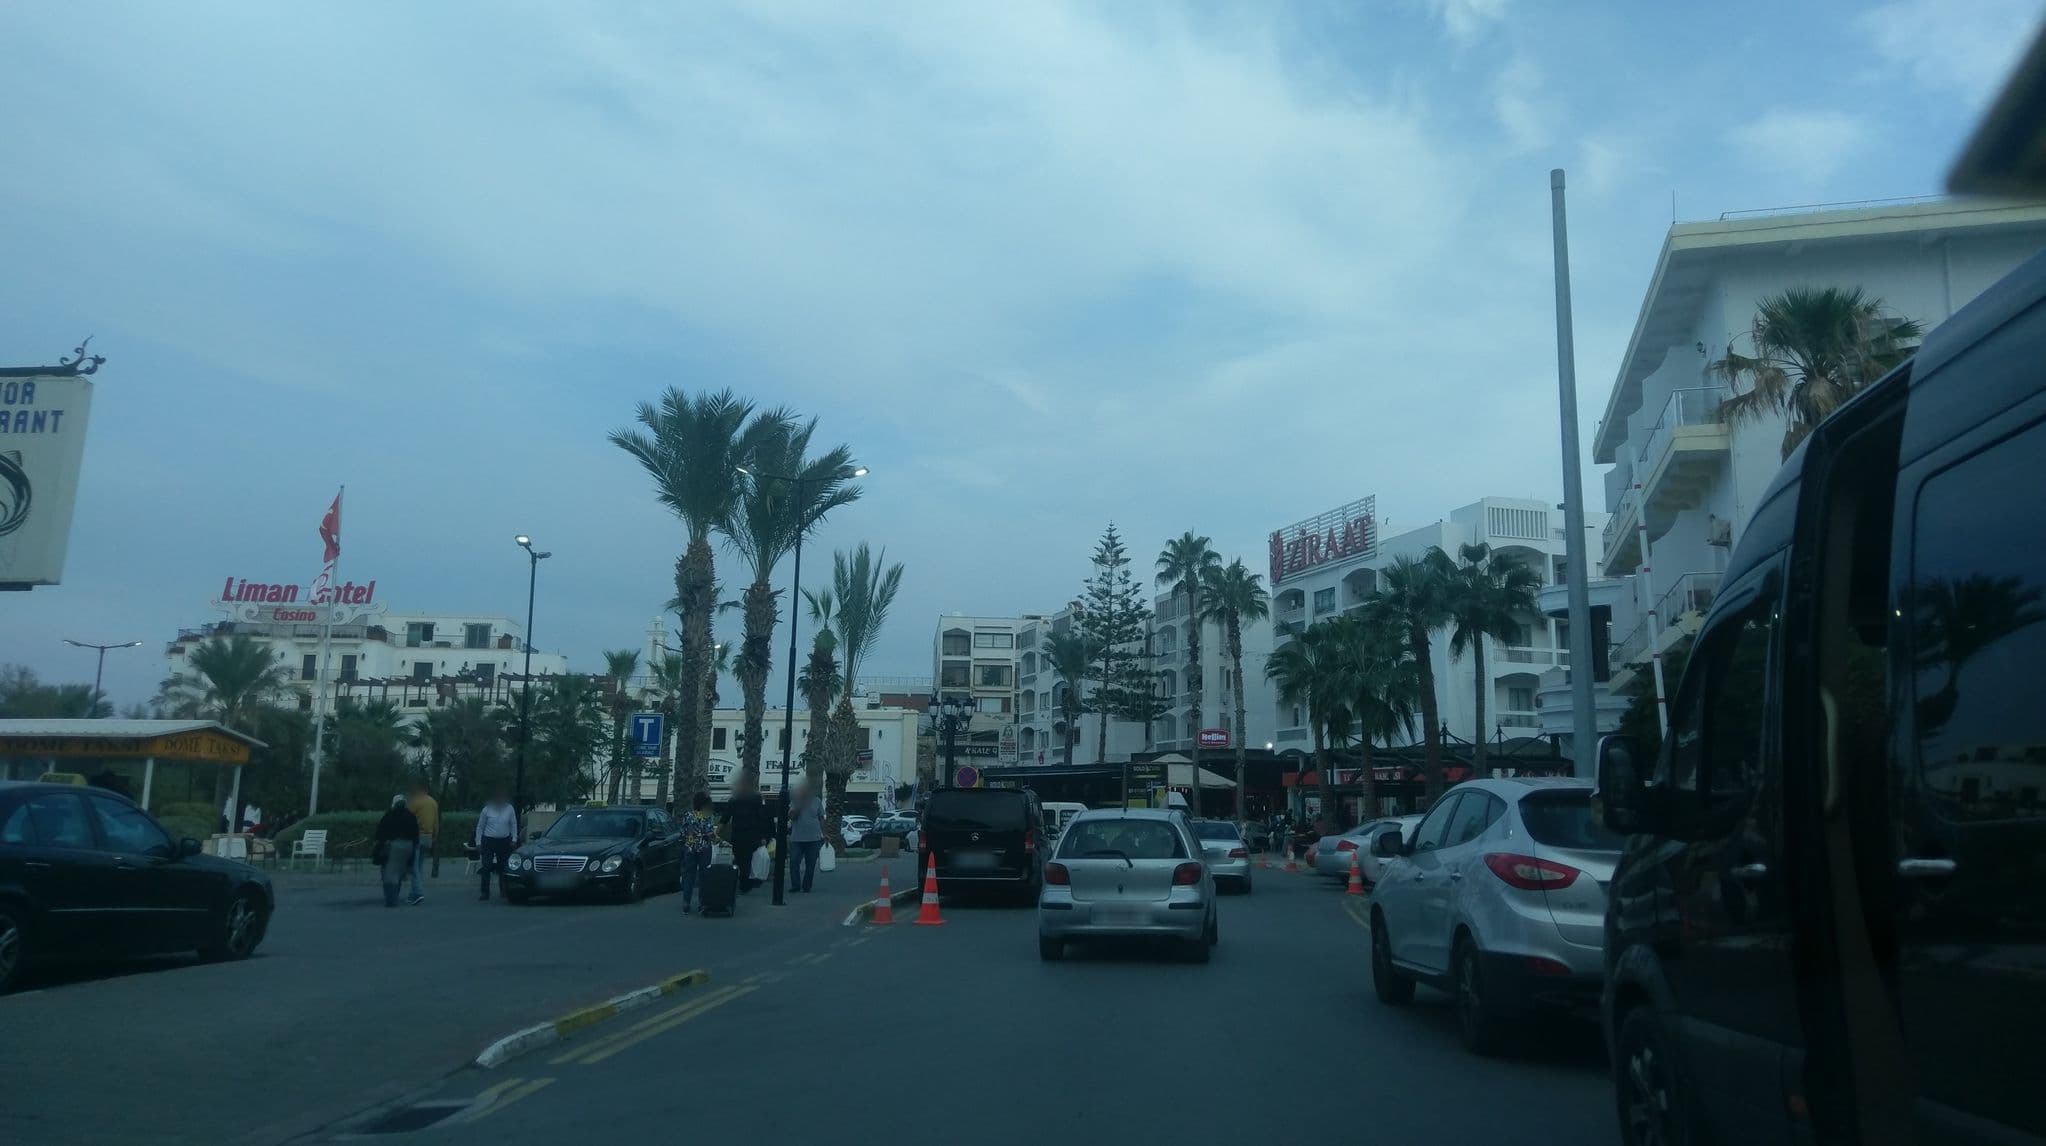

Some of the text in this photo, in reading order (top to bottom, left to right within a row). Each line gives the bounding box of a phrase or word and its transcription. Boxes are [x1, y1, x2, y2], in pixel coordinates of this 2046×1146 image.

[0, 382, 35, 405] OR
[222, 577, 376, 604] Liman otel
[273, 608, 316, 622] Casino
[638, 718, 655, 742] T
